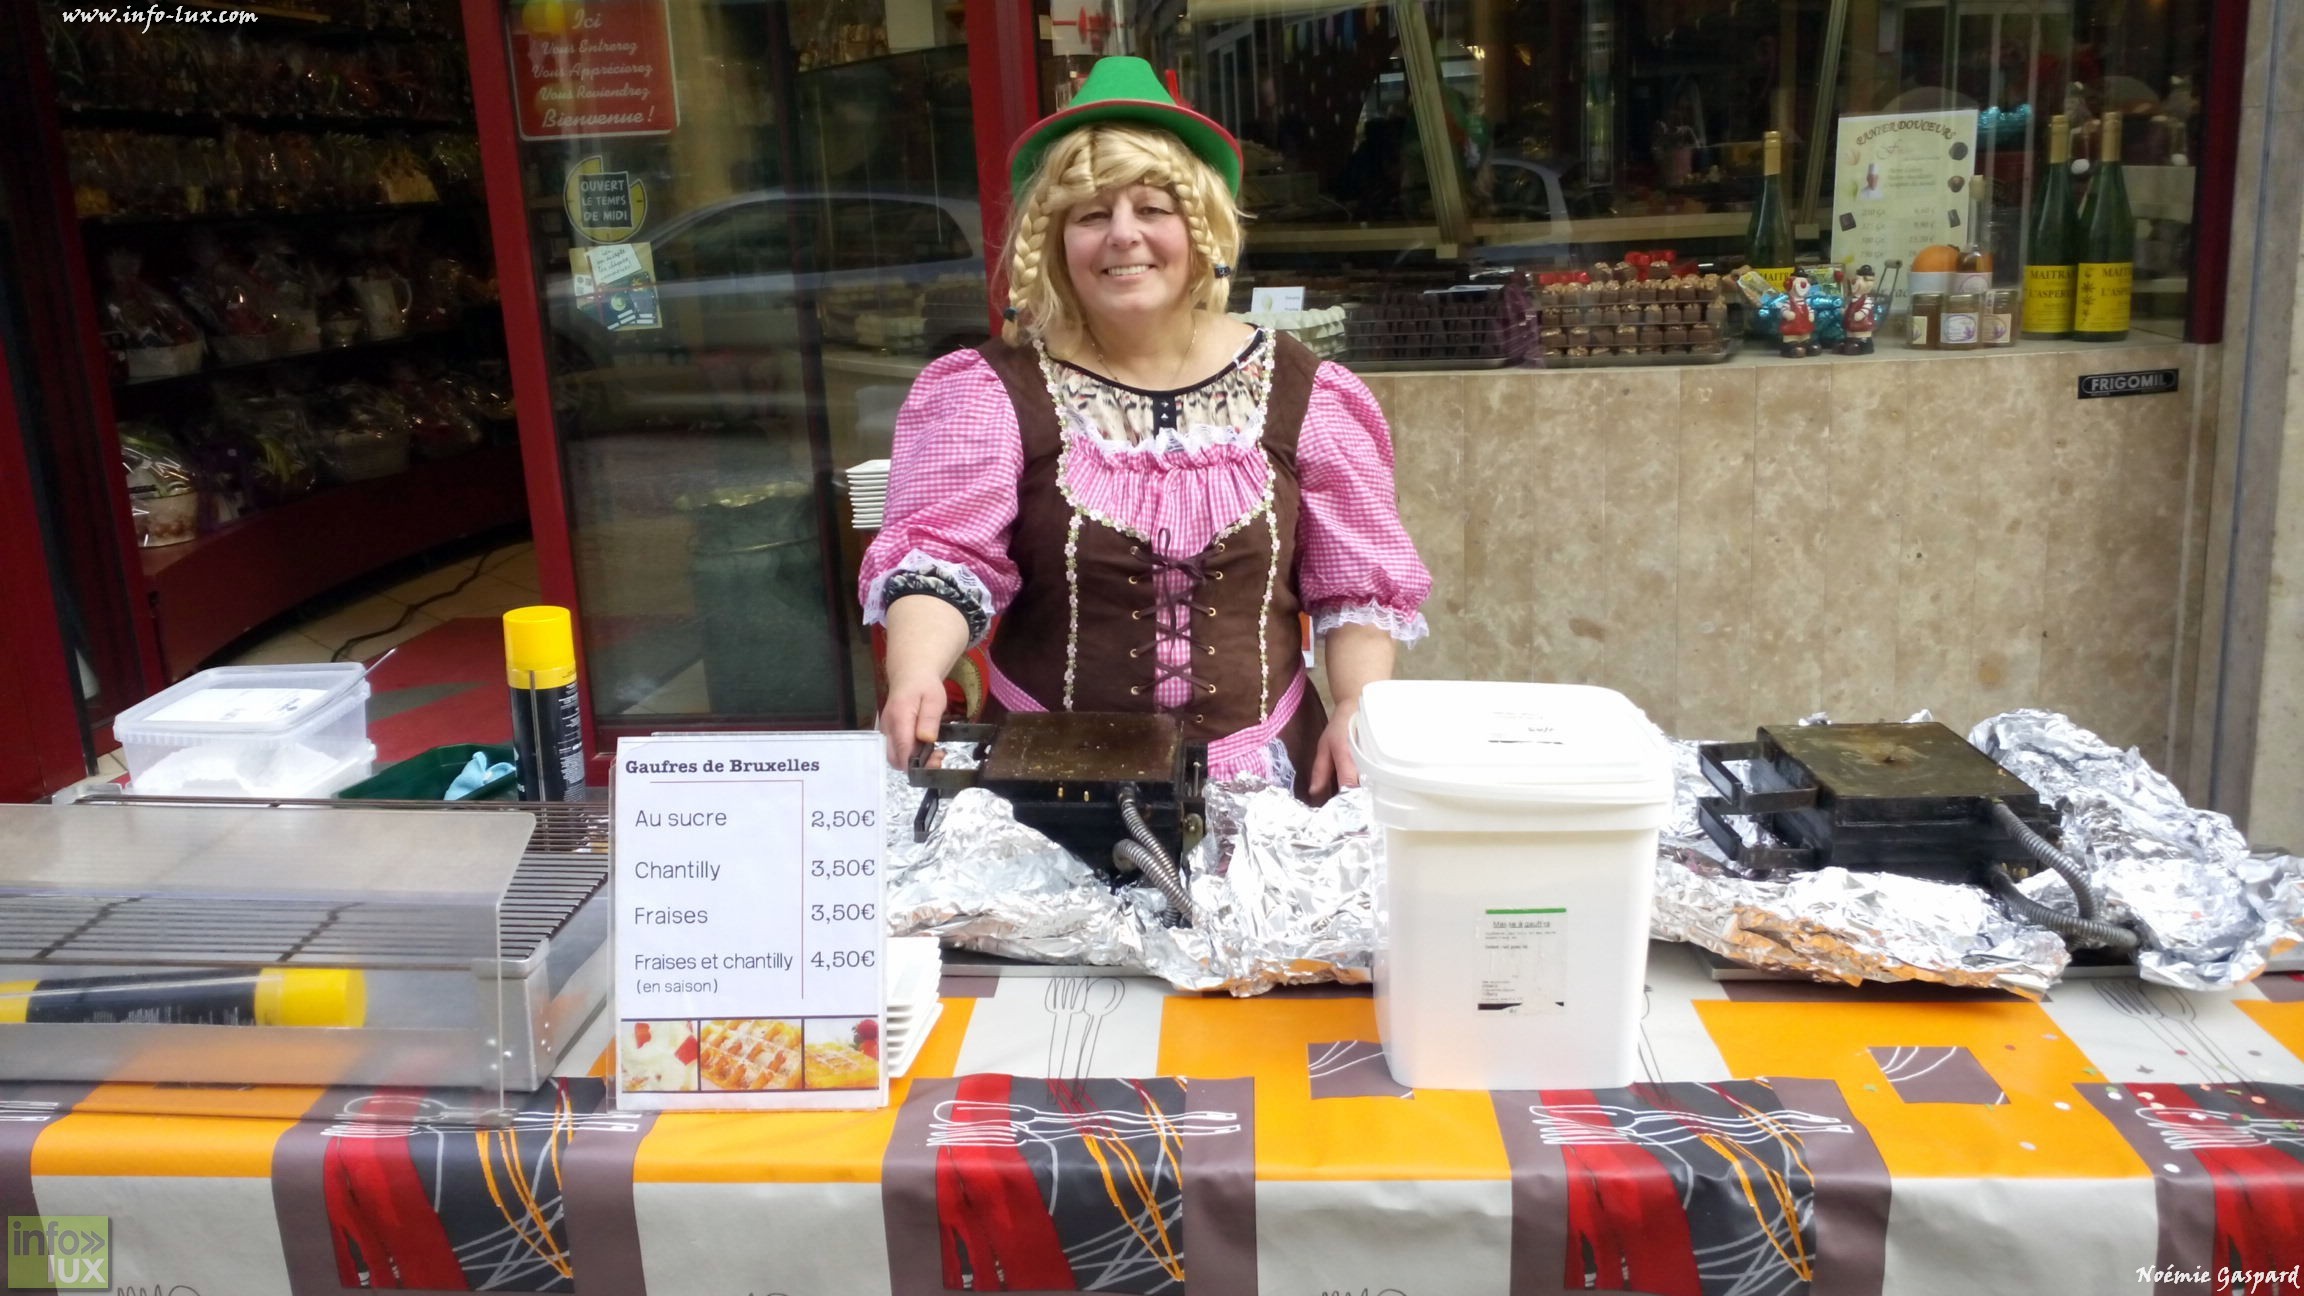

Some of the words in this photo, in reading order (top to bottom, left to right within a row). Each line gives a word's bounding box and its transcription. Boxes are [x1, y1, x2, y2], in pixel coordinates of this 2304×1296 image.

[572, 8, 602, 30] Ici
[541, 41, 575, 55] Vous
[532, 65, 565, 79] Vous
[539, 87, 574, 101] Vous
[581, 179, 625, 192] OUVERT
[582, 197, 593, 207] LE
[596, 195, 626, 206] TEMPS
[583, 211, 599, 222] DE
[602, 210, 628, 221] MIDI
[2091, 373, 2168, 392] FRIGOMIL
[625, 759, 698, 774] Gaufres
[702, 759, 725, 773] de
[729, 758, 820, 773] Bruxelles
[635, 809, 662, 828] Au
[668, 810, 728, 827] sucre
[811, 809, 875, 831] 2,50€
[634, 860, 721, 882] Chantilly
[811, 858, 875, 880] 3,50€
[634, 906, 708, 925] Fraises
[811, 903, 875, 925] 3,50€
[634, 953, 697, 971] Fraises
[701, 953, 718, 970] et
[723, 951, 793, 972] chantilly
[810, 950, 875, 971] 4,50€
[636, 978, 661, 994] (en
[664, 977, 719, 994] saison)
